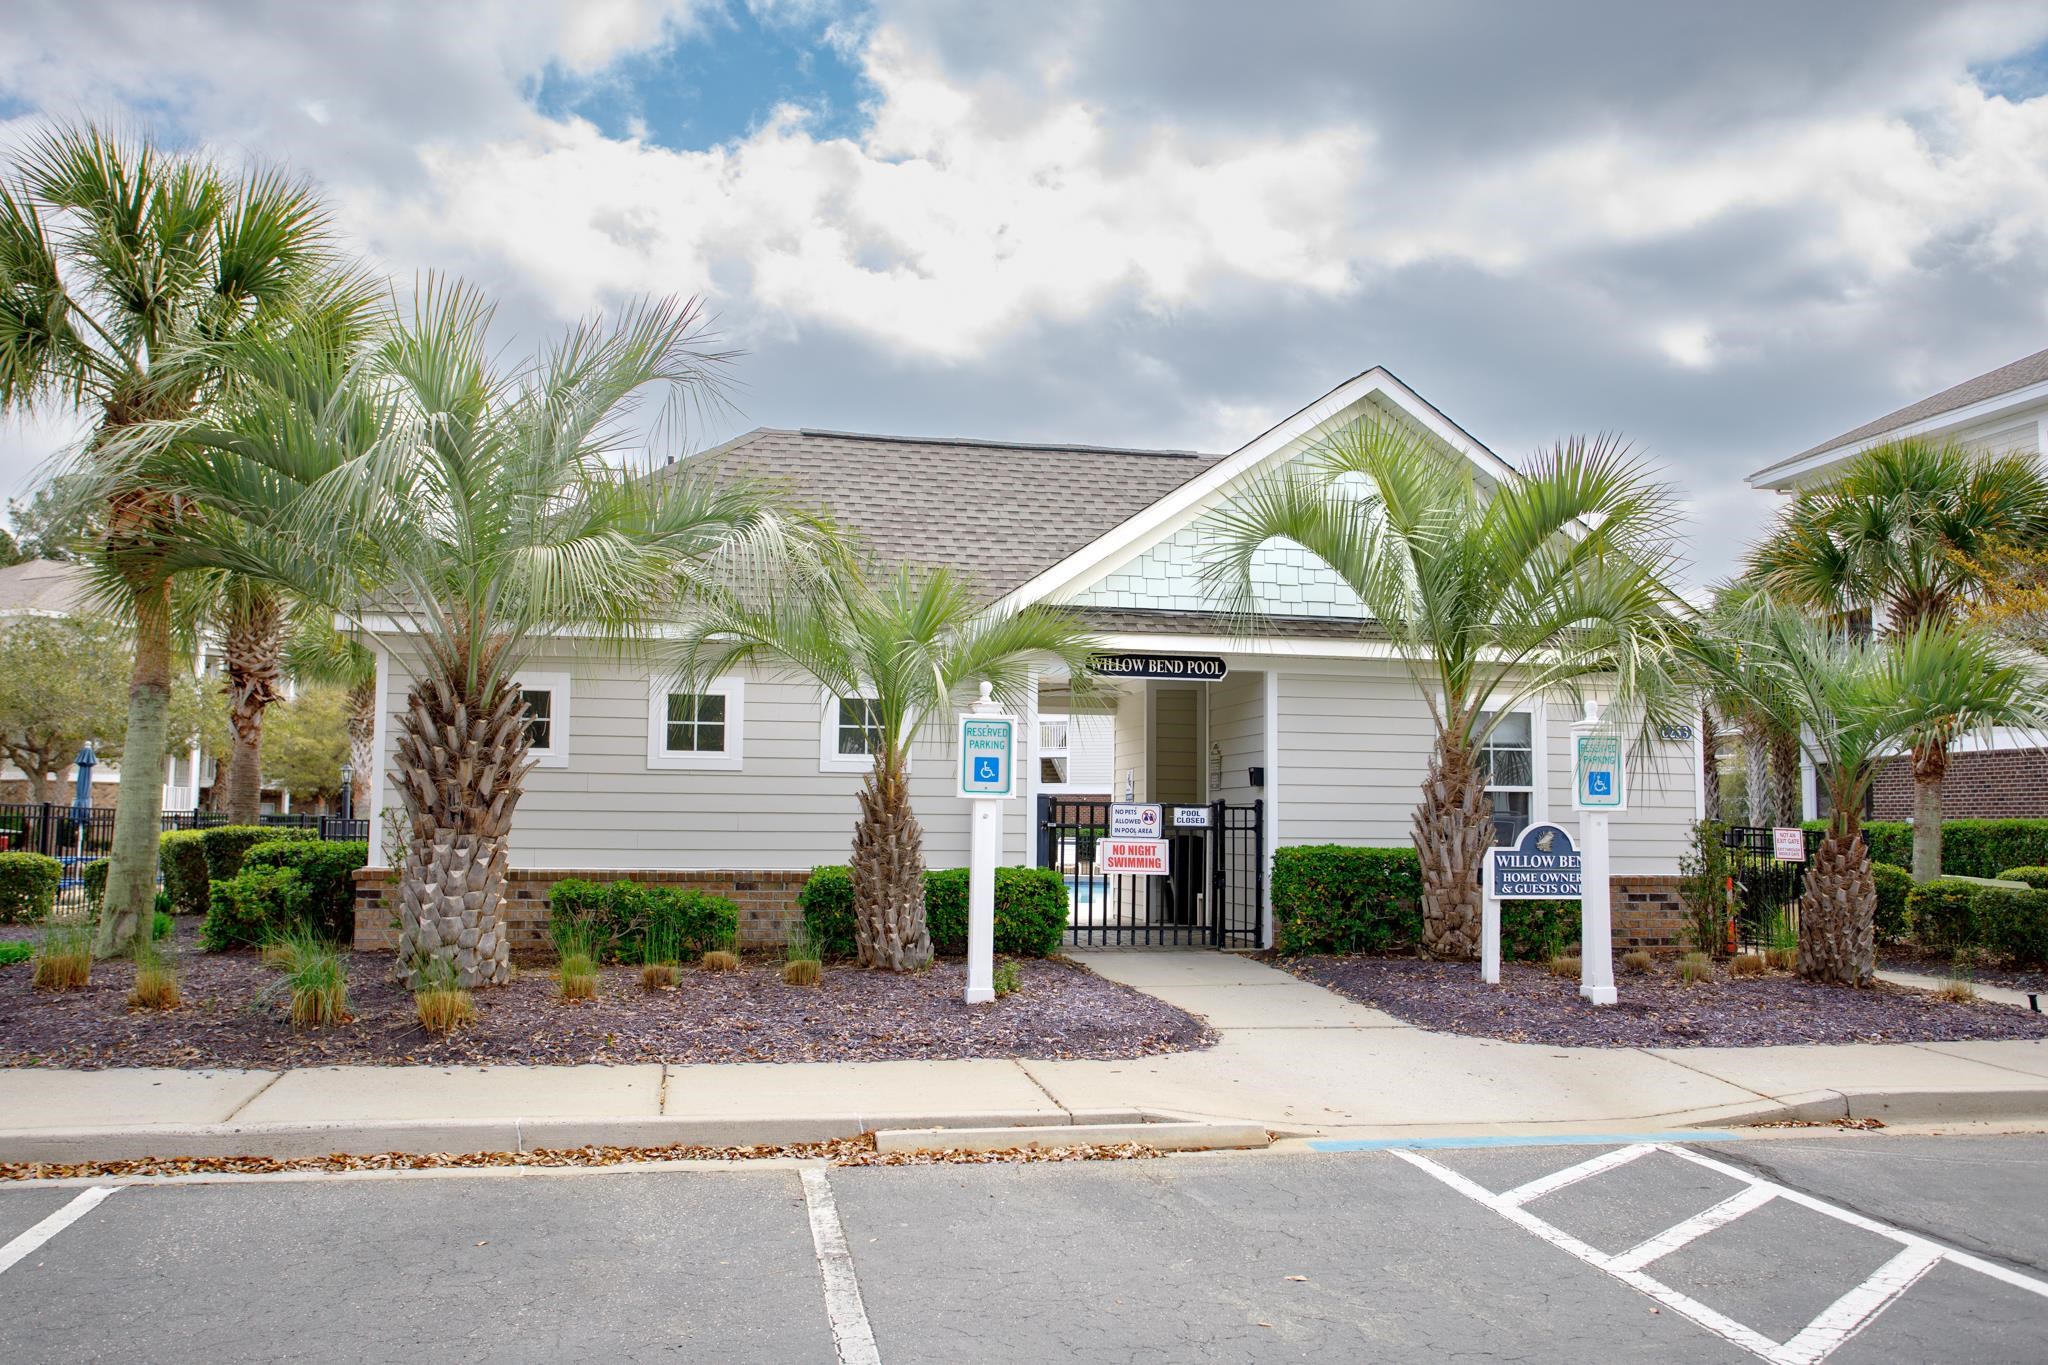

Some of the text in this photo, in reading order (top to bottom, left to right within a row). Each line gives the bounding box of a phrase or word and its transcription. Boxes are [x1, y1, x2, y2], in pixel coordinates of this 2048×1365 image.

[1091, 658, 1223, 675] WILLOW BEND POOL
[966, 727, 1008, 738] RESERVED
[969, 740, 1005, 750] PARKING
[1112, 844, 1157, 856] NO NIGHT
[1107, 856, 1161, 869] SWIMMING
[1496, 855, 1556, 868] WILLOW
[1503, 872, 1538, 883] HOME
[1502, 884, 1513, 893] &
[1515, 883, 1558, 894] GUESTS
